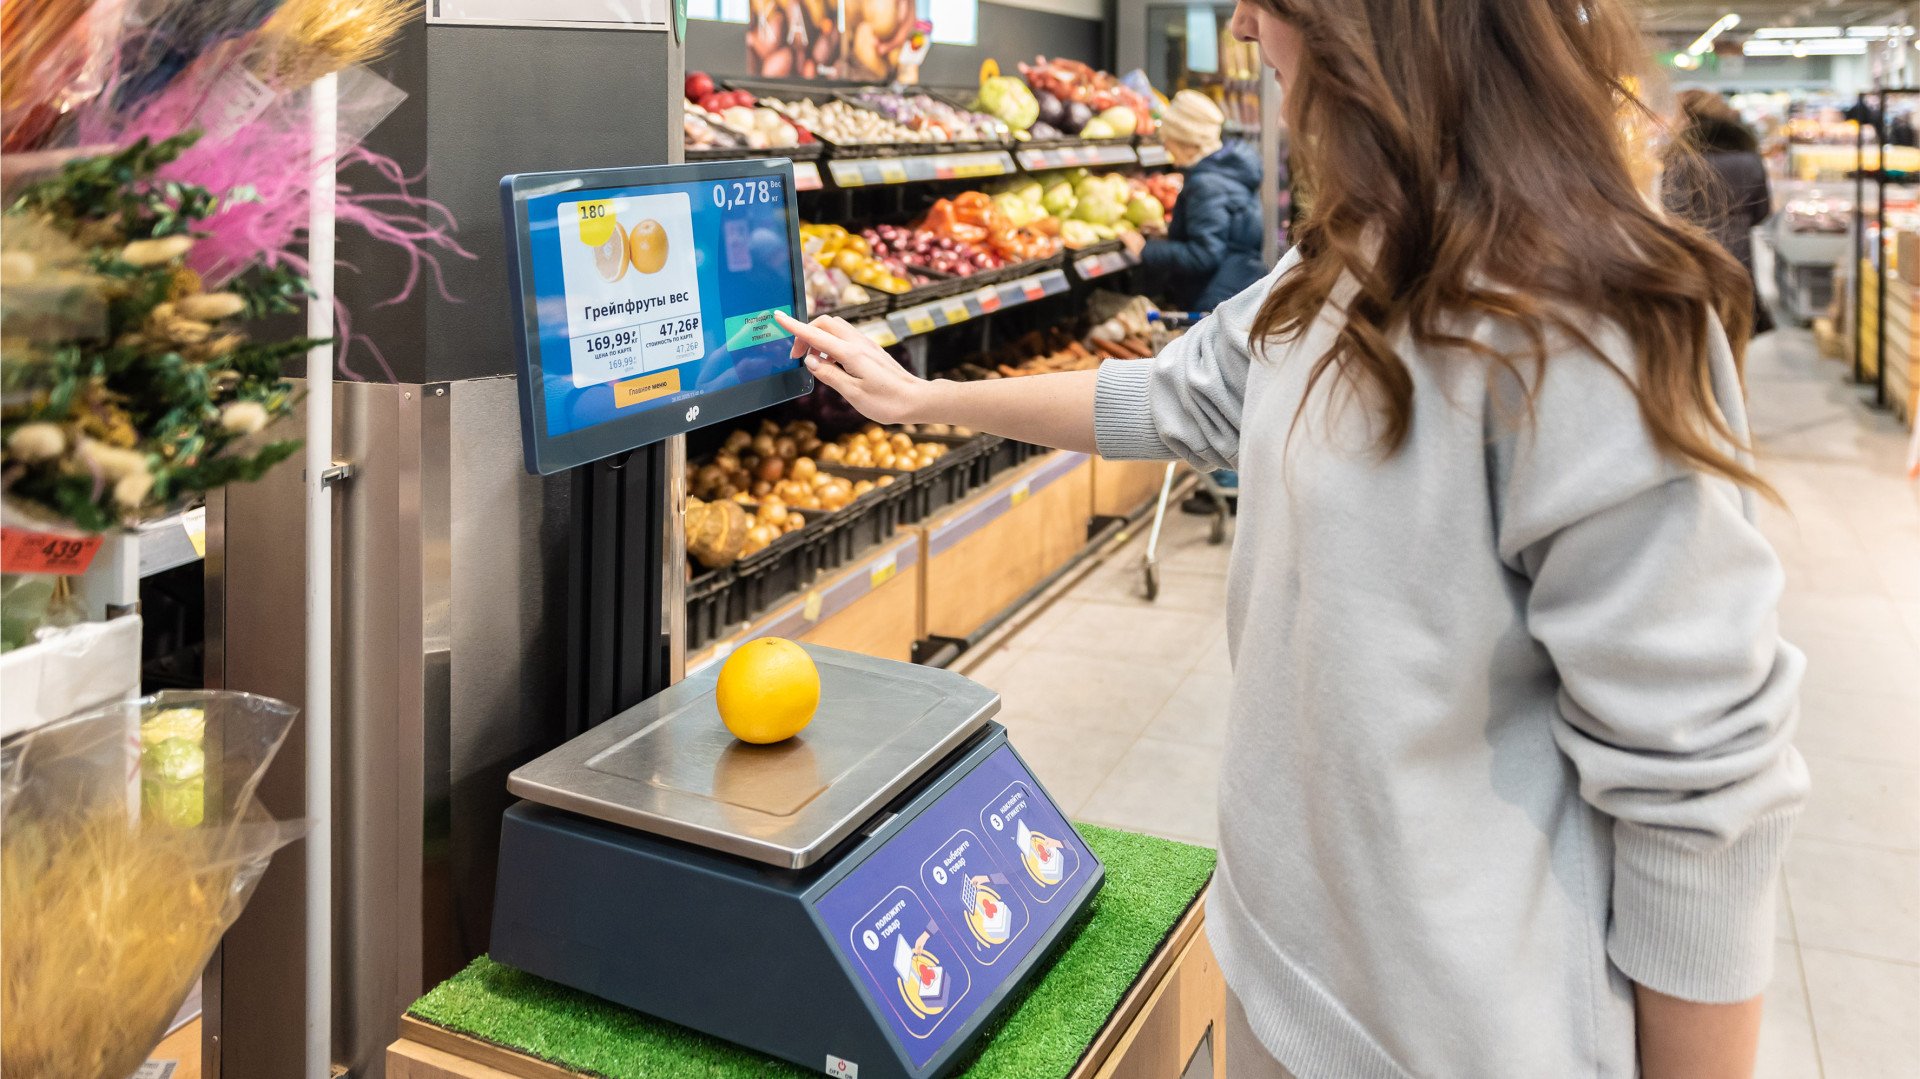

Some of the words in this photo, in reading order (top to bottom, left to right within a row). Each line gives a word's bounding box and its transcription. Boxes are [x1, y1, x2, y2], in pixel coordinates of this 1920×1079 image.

[713, 181, 770, 211] 0,278
[770, 180, 782, 188] Вес
[580, 204, 606, 220] 180
[584, 296, 667, 321] Грейпфруты
[669, 291, 690, 304] вес
[659, 317, 700, 337] 47,26₽
[680, 333, 693, 341] КАРТЕ
[586, 331, 631, 353] 169,99
[594, 352, 609, 360] ЦЕНА
[617, 347, 632, 355] КАРТЕ
[608, 356, 633, 370] 169,99
[628, 384, 652, 396] Главное
[651, 381, 668, 390] меню
[41, 539, 83, 559] 439
[943, 840, 970, 867] выберите
[948, 857, 966, 875] товар
[874, 899, 906, 931] положите
[880, 918, 901, 939] товар
